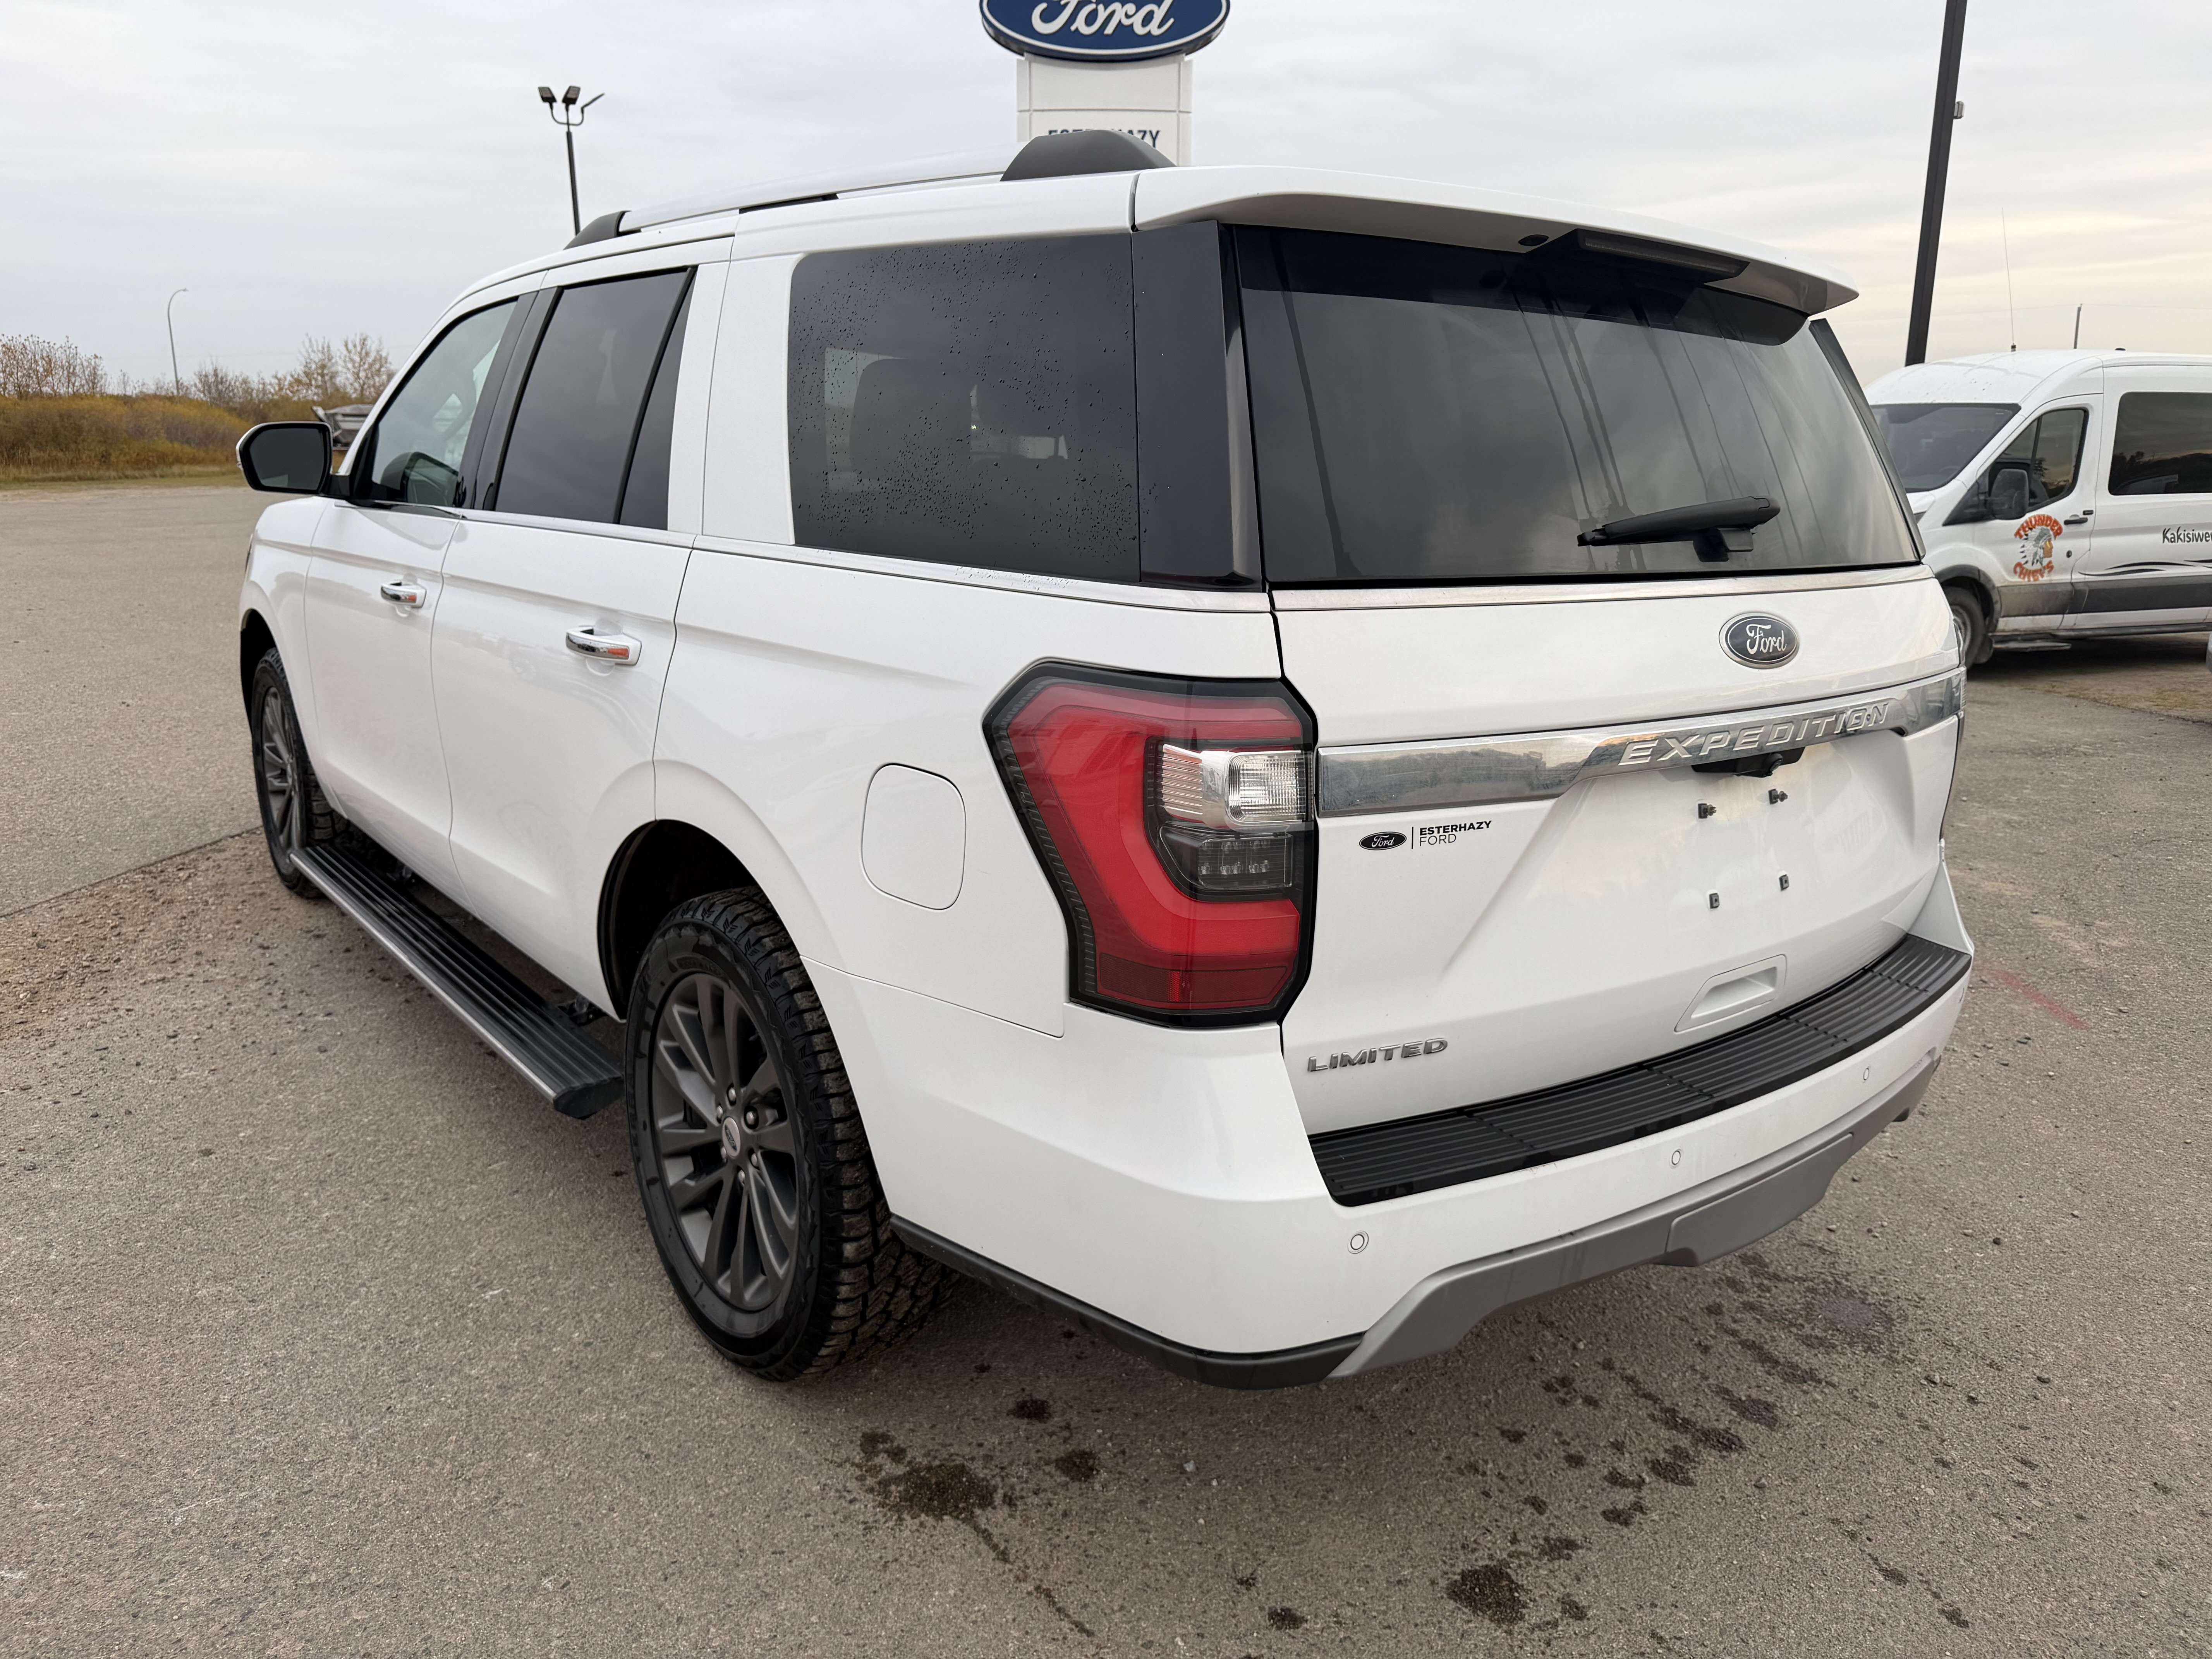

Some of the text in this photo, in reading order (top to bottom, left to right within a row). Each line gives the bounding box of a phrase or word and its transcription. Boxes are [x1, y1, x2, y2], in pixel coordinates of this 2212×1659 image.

[2014, 514, 2063, 540] THUNDER
[2162, 526, 2212, 544] Kakisiwe
[1746, 623, 1787, 654] Ford
[1618, 702, 1889, 766] EXPEDITION
[1419, 821, 1492, 836] ESTERHAZY
[1419, 833, 1456, 846] FORD
[1371, 835, 1394, 847] Ford
[1307, 1038, 1448, 1072] LIMITED
